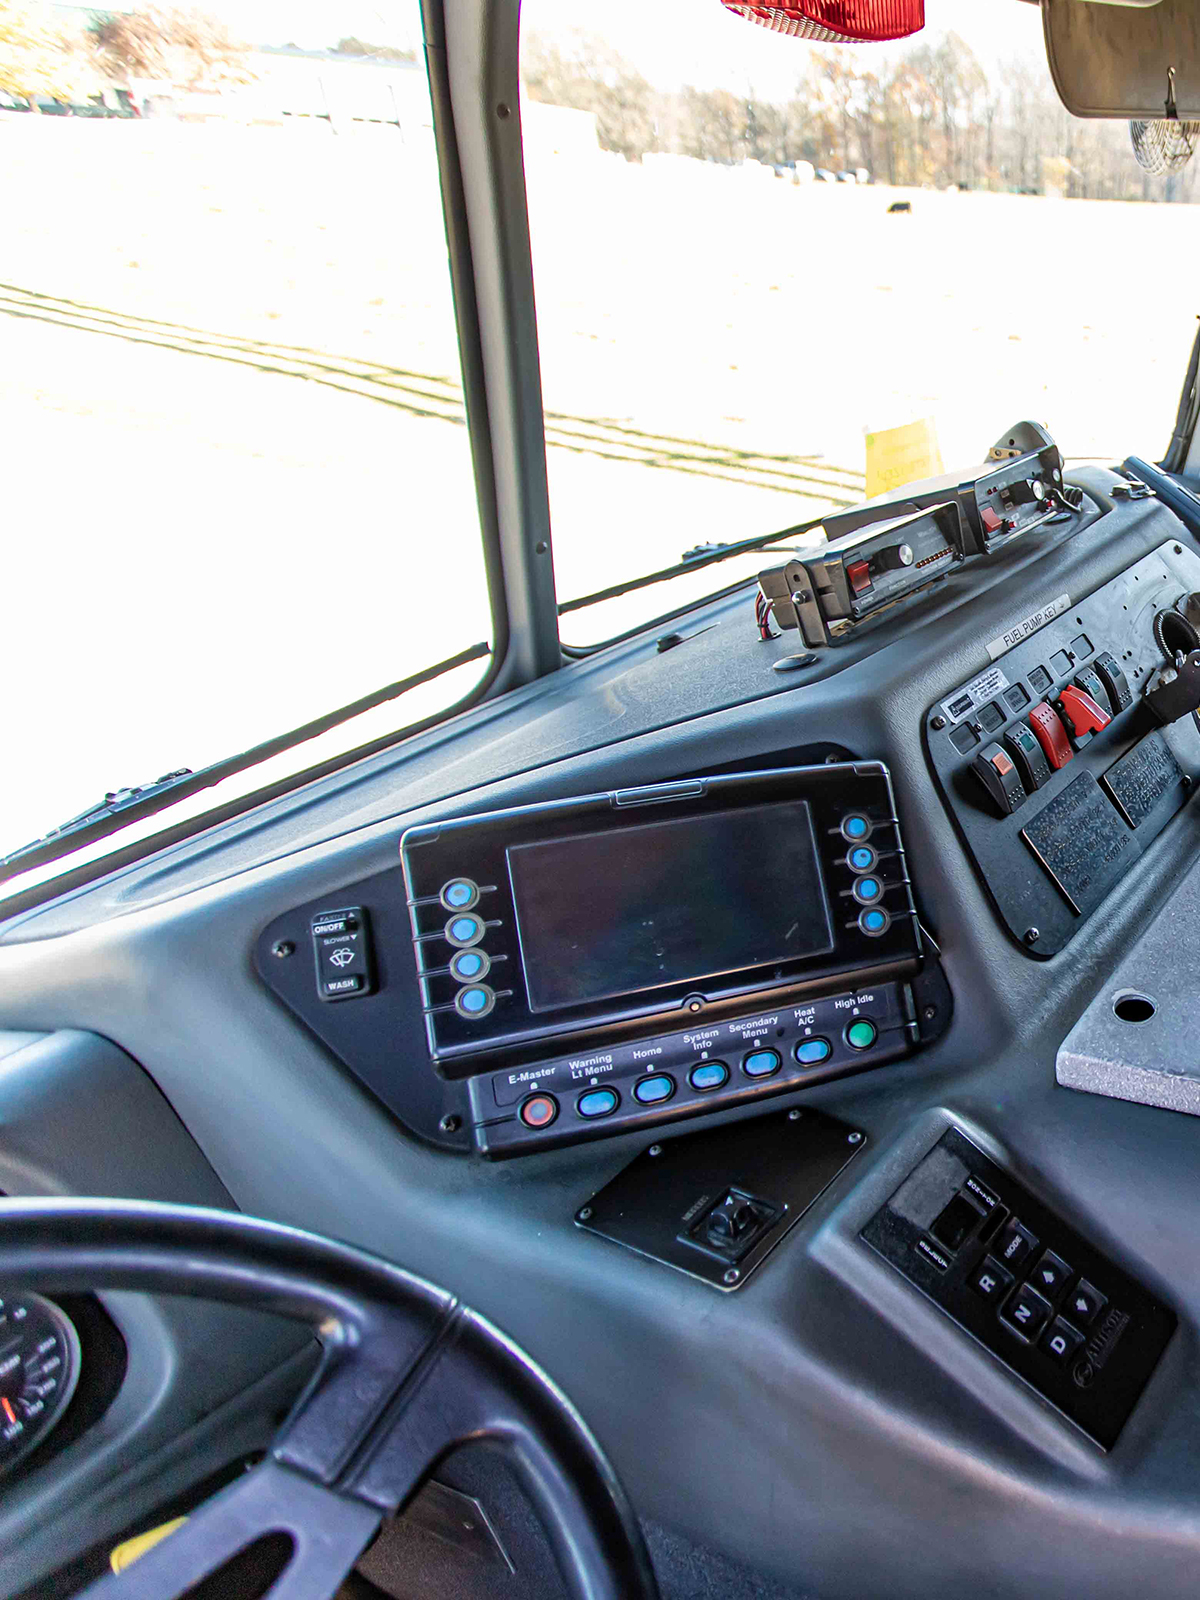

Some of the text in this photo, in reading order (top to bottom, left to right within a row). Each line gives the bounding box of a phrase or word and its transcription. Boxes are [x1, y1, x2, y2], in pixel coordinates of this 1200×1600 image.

[1003, 604, 1058, 647] FUEL PUMP KEY
[314, 922, 344, 934] ON/OFF
[328, 979, 354, 990] WASH
[834, 994, 874, 1009] High Idle
[794, 1006, 816, 1018] Heat
[728, 1015, 779, 1033] Secondary
[798, 1016, 815, 1026] A/C
[683, 1029, 719, 1044] System
[742, 1027, 768, 1039] Menu
[633, 1047, 663, 1059] Home
[693, 1039, 713, 1051] Info
[569, 1054, 613, 1070] Warning
[508, 1067, 556, 1085] E-Master
[571, 1064, 613, 1080] Lt Menu
[967, 1179, 996, 1207] MONITOR
[1004, 1235, 1023, 1259] MODE
[978, 1274, 997, 1293] R
[1014, 1304, 1032, 1323] N
[1050, 1335, 1067, 1354] D
